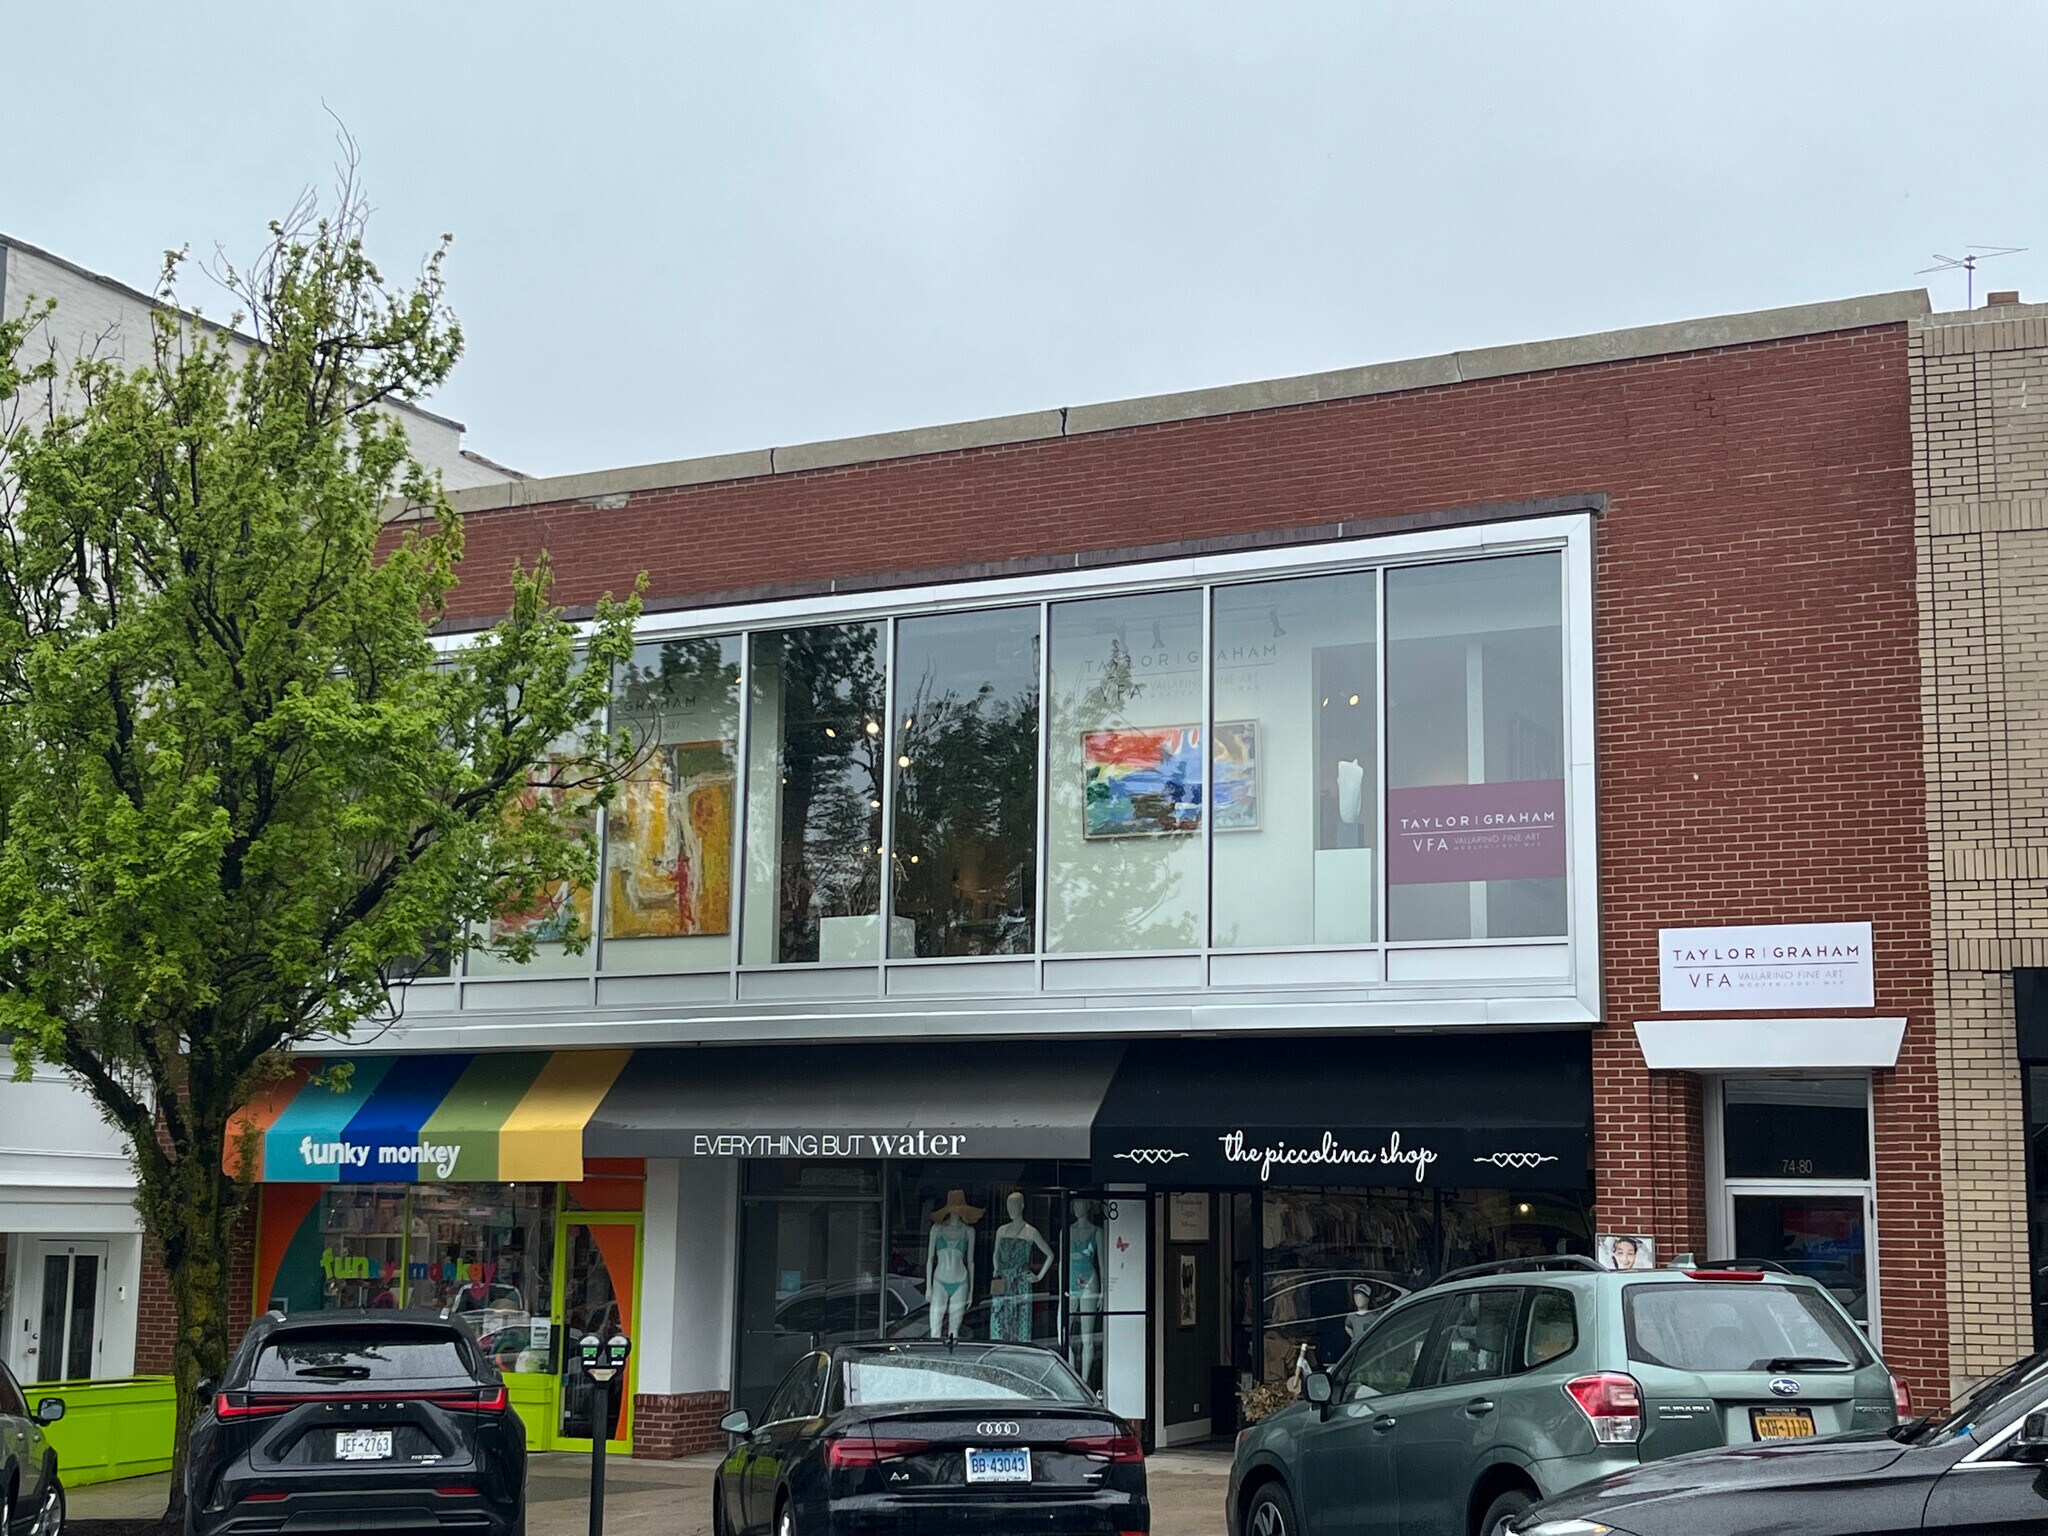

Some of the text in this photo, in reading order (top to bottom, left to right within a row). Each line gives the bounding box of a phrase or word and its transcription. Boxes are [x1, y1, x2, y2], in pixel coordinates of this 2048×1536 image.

[1188, 645, 1277, 663] GAHAM
[1099, 684, 1143, 702] VFA
[624, 696, 696, 712] GRAHAM
[1401, 811, 1555, 830] TAYLOR GRAHAM
[1525, 832, 1541, 841] ART
[1412, 838, 1449, 852] VFA
[1673, 945, 1859, 961] TAYLOR GRAHAM
[1689, 973, 1732, 988] VFA
[1738, 969, 1844, 981] VALLARINO FINE ART
[694, 1130, 967, 1156] EVERYTHING BUT water
[300, 1135, 461, 1179] funky monkey
[1218, 1129, 1438, 1183] the piccolina shop
[1782, 1159, 1813, 1174] 74-80
[320, 1247, 497, 1300] funky monkey
[325, 1402, 405, 1411] LEXUS
[890, 1471, 910, 1482] A4
